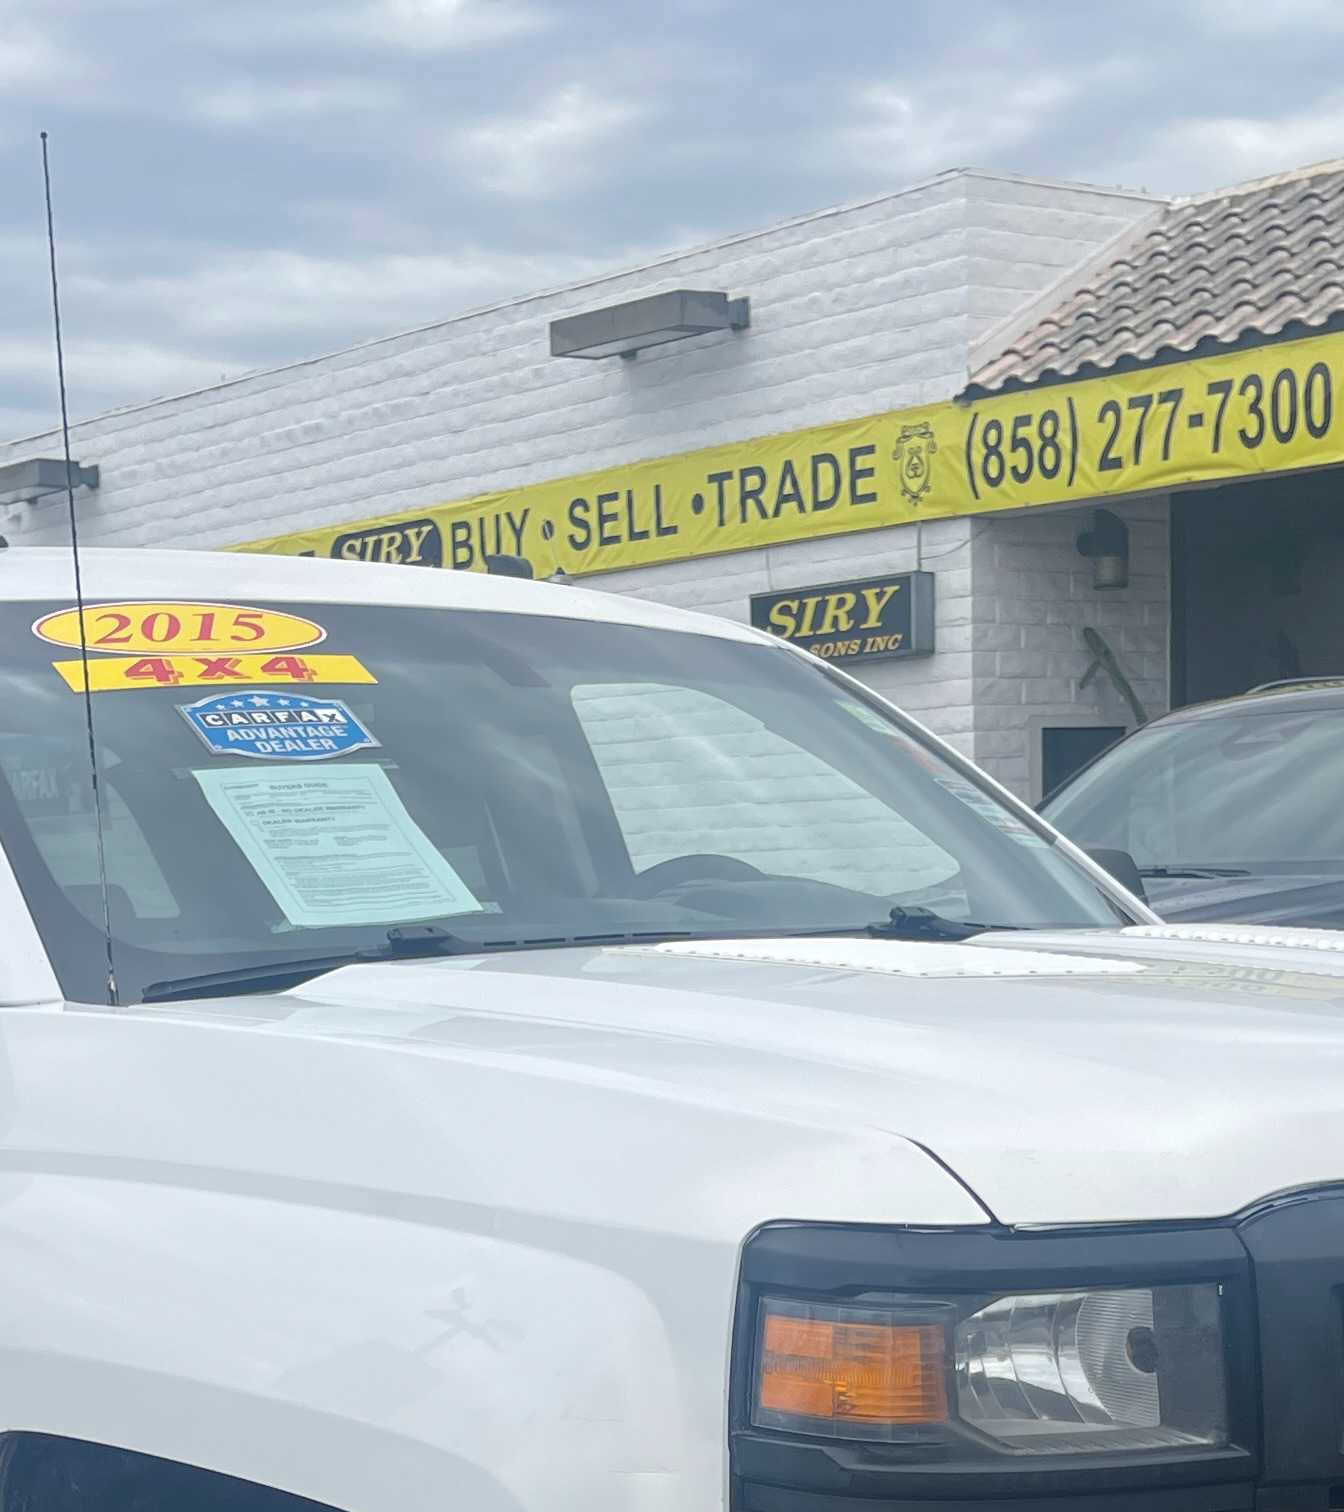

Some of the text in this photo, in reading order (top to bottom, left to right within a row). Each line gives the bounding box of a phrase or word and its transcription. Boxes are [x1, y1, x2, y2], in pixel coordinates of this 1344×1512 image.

[965, 361, 1333, 500] (858) 277-7300
[451, 444, 878, 573] BUY SELL TRADE
[340, 525, 433, 565] SIRY
[94, 612, 266, 645] 2015
[765, 584, 901, 641] SIRY
[863, 633, 903, 653] INC
[203, 707, 348, 728] CARFAX
[225, 723, 349, 742] ADVANTAGE
[254, 738, 339, 754] DEALER
